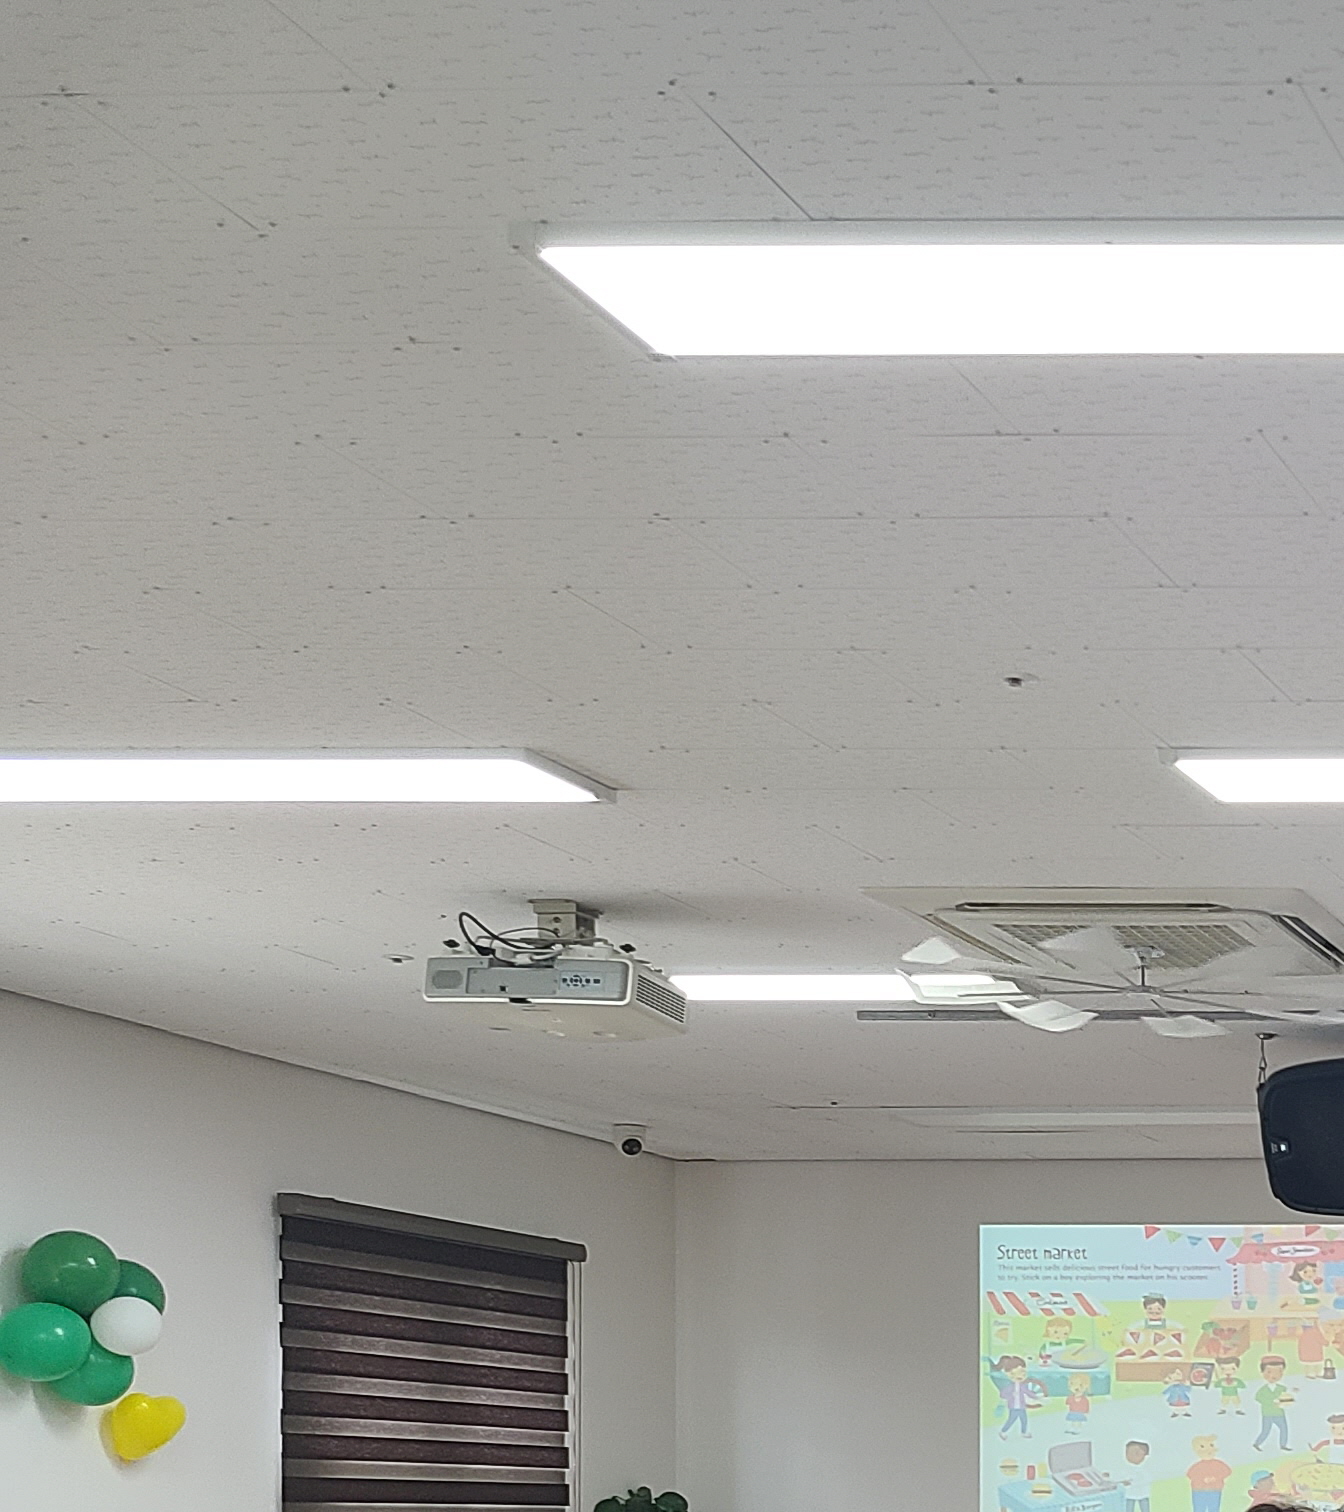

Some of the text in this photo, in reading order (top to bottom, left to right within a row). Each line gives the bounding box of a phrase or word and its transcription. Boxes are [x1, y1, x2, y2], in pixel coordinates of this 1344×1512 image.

[997, 1244, 1088, 1260] Street market
[1121, 1264, 1138, 1273] food
